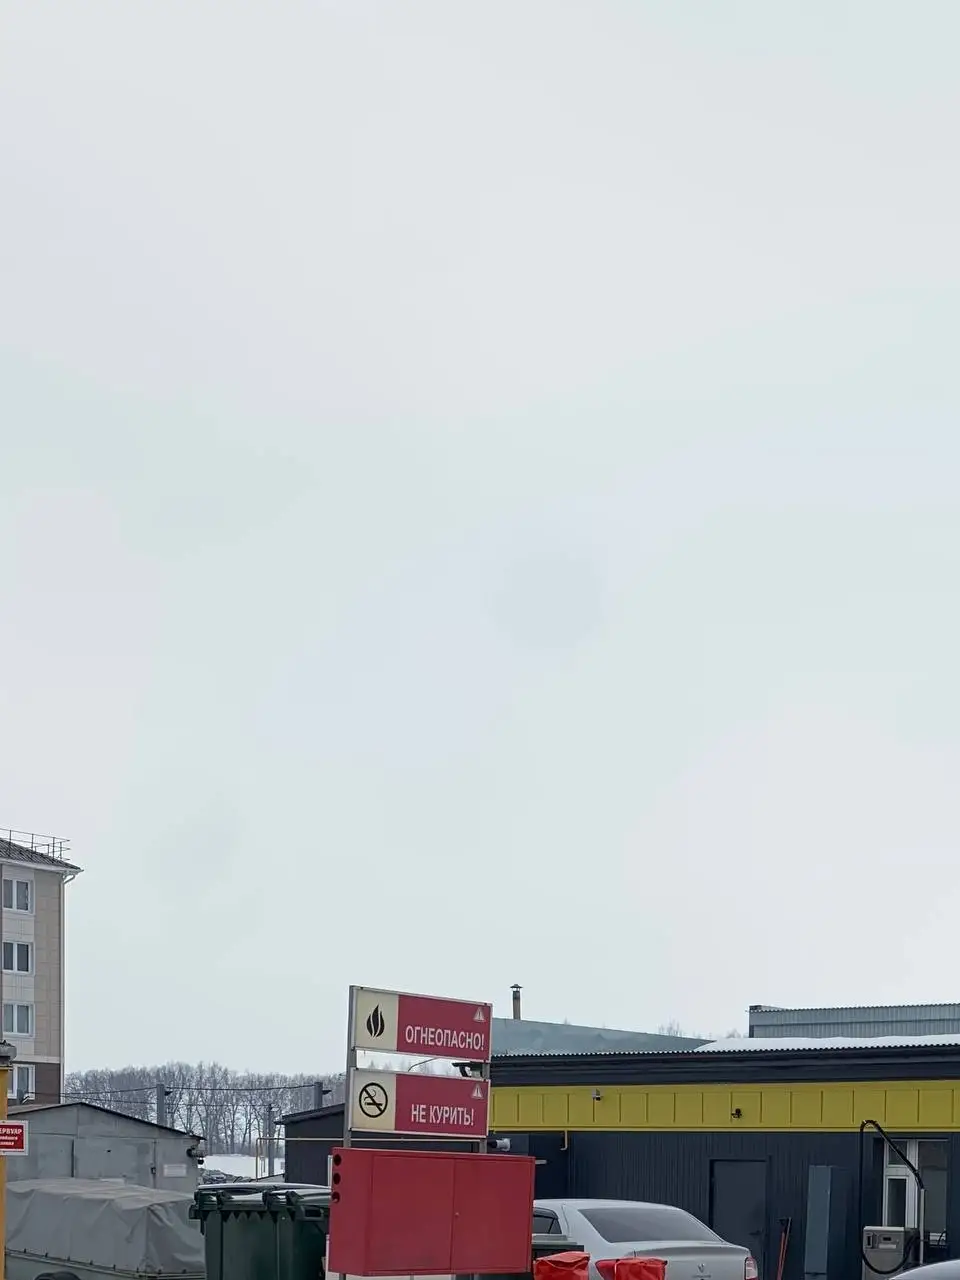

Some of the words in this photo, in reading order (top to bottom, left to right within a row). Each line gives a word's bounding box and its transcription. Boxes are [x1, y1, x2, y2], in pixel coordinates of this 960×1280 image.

[405, 1025, 485, 1051] ОГНЕОПАСНО!
[411, 1103, 427, 1123] НЕ
[429, 1105, 475, 1126] КУРИТЬ!
